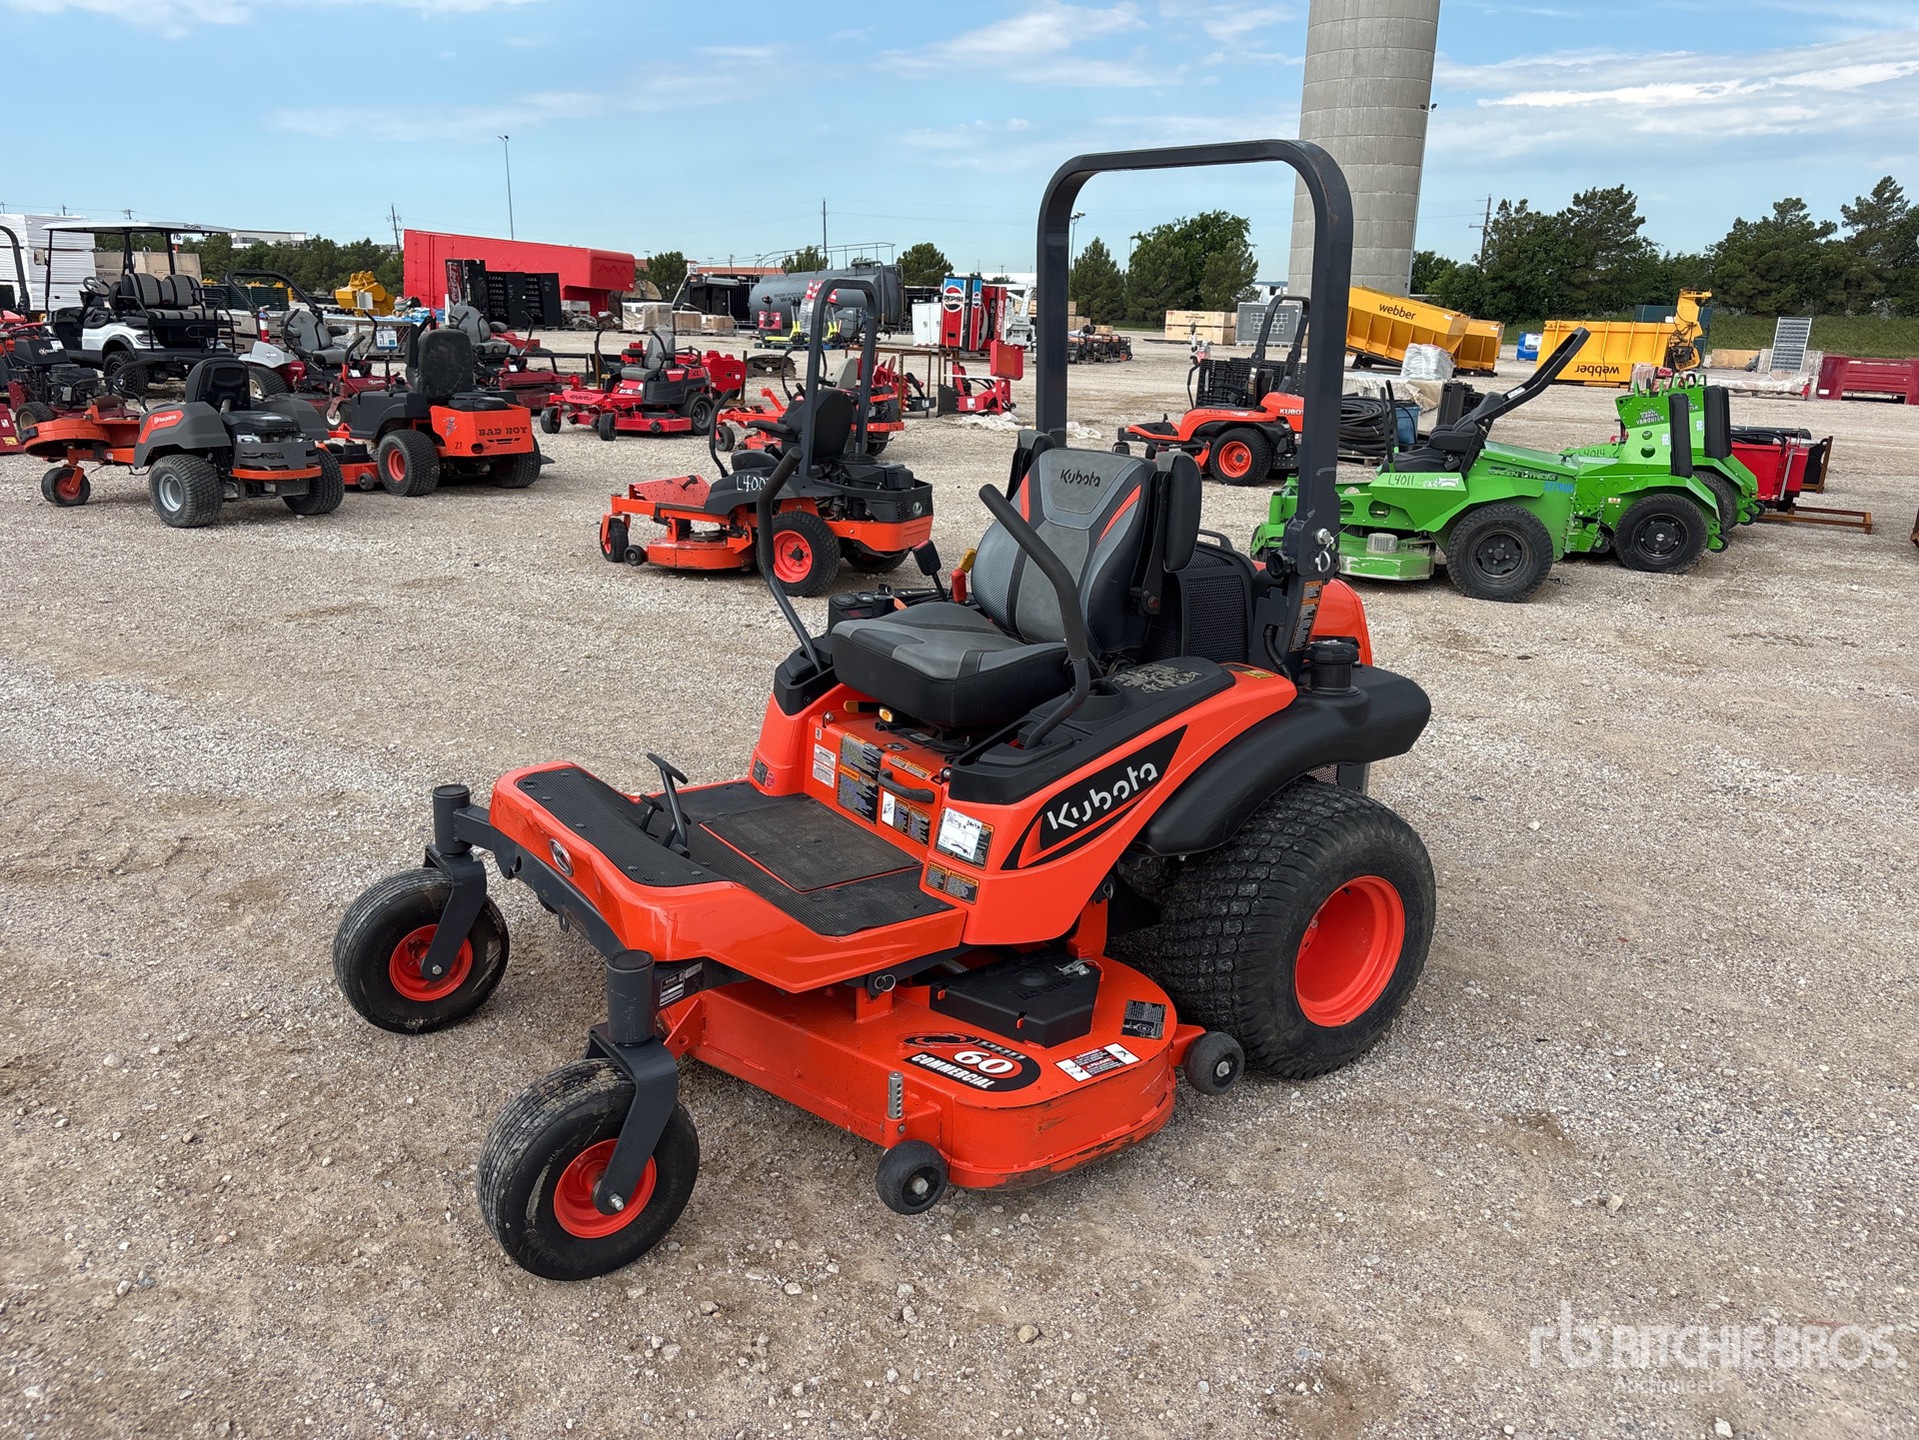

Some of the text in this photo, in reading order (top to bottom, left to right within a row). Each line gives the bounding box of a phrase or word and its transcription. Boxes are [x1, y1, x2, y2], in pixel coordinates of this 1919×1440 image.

[944, 295, 964, 303] PEPSI
[1379, 303, 1417, 321] webber
[1575, 364, 1620, 377] webber
[478, 426, 528, 437] BAD BOY
[454, 441, 464, 450] ZT
[1060, 468, 1102, 488] Kubota
[1388, 474, 1415, 486] L4011
[1046, 762, 1159, 831] Kubota
[953, 1050, 1014, 1075] 60
[910, 1053, 996, 1089] COMMERCIAL
